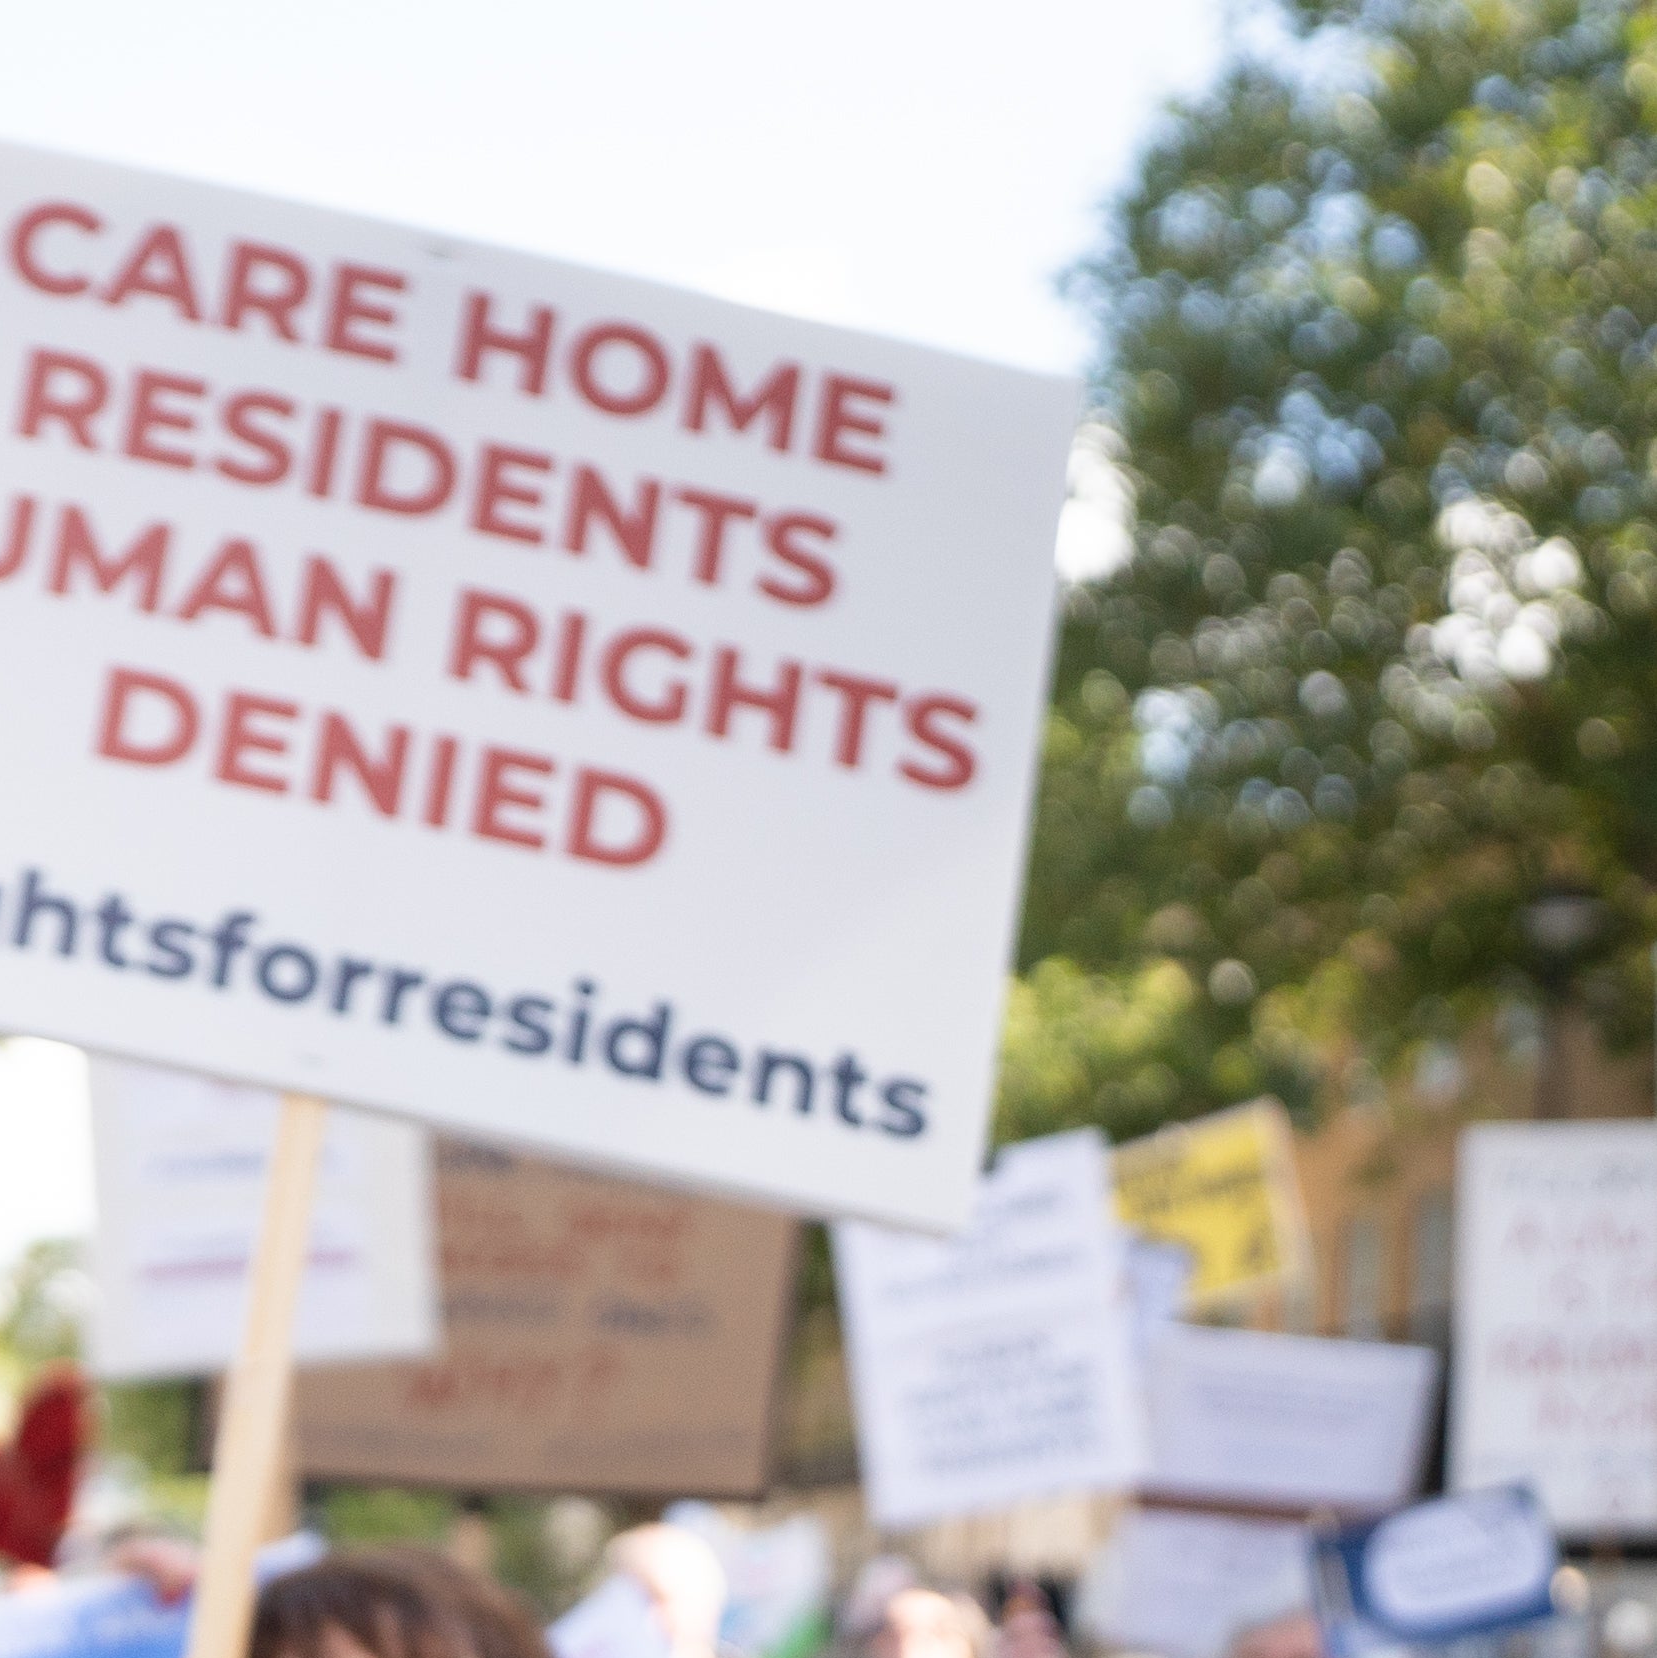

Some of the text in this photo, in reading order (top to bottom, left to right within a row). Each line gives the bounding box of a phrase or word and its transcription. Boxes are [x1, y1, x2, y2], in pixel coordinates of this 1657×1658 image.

[3, 200, 900, 480] CARE HOME
[14, 347, 842, 611] RESIDENTS
[93, 665, 672, 872] DENIED
[445, 587, 982, 796] RIGHTS
